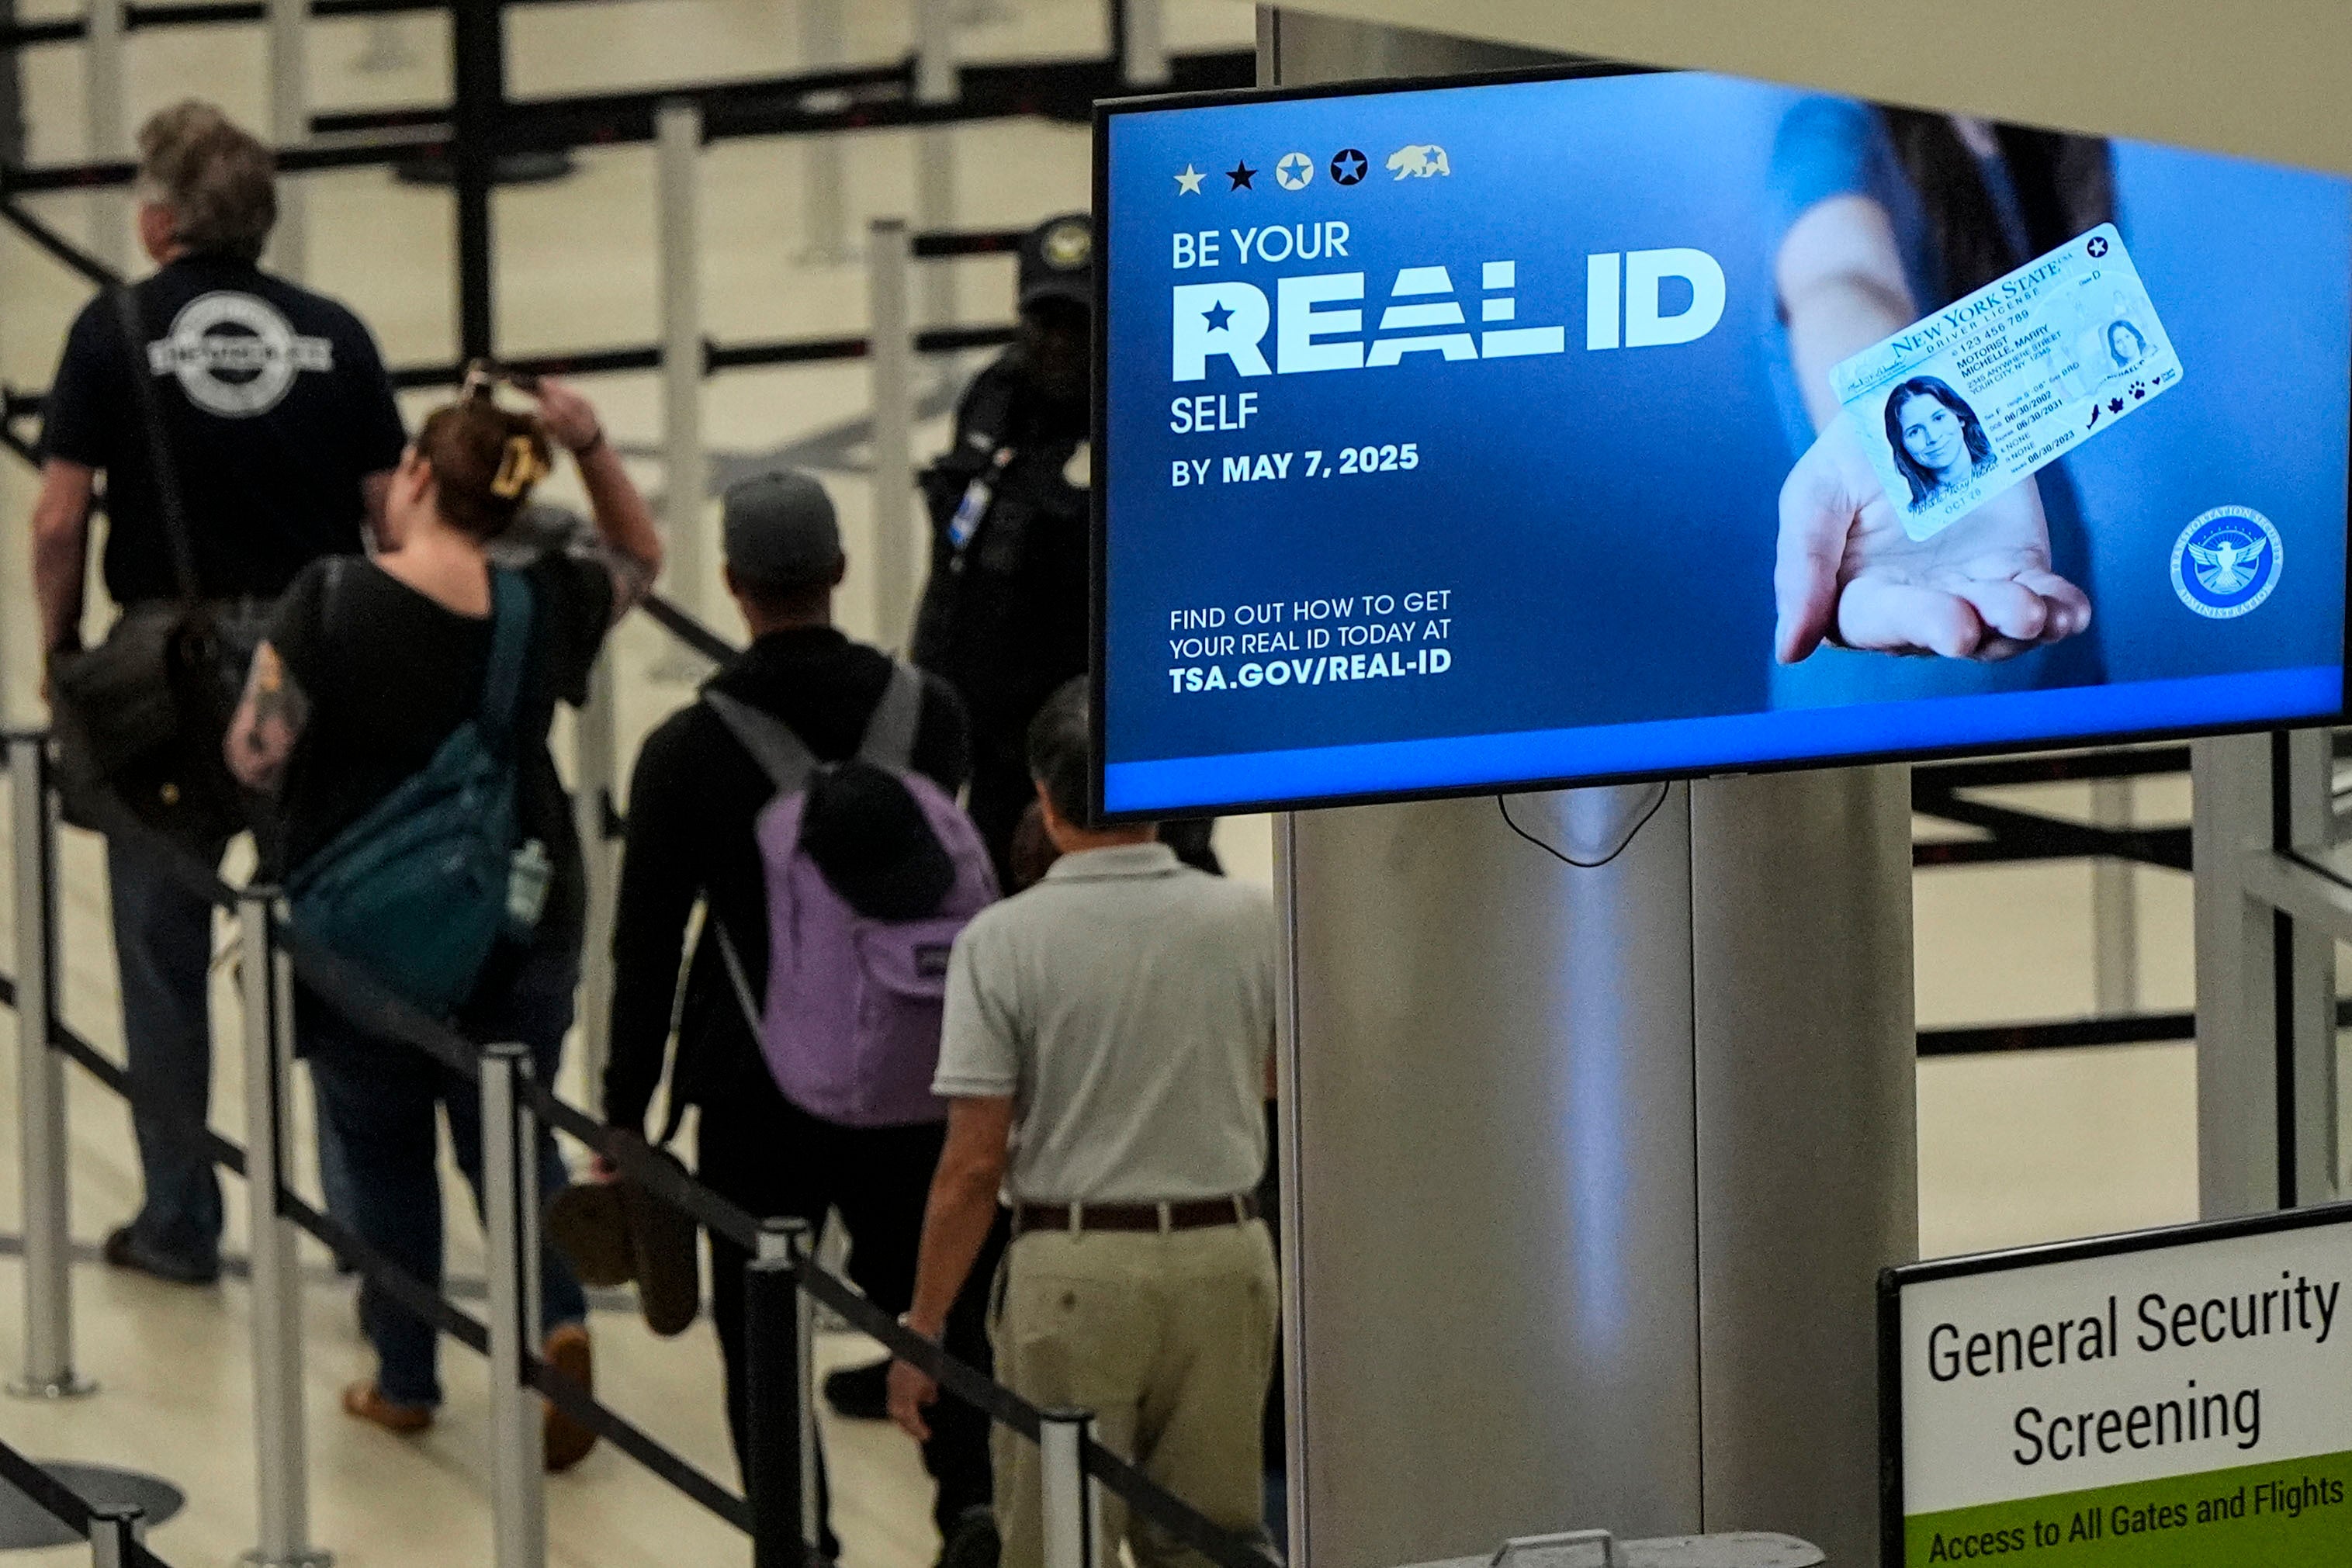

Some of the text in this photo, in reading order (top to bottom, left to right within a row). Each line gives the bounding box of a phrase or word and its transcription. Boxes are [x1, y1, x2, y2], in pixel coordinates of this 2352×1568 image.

[1172, 220, 1350, 269] BE YOUR
[2091, 269, 2101, 280] D
[1172, 247, 1727, 382] REAL ID
[1890, 322, 1940, 358] NEW
[1942, 292, 2001, 328] YORK
[2001, 261, 2061, 299] STATE
[1926, 286, 2040, 353] DRIVER LICENSE
[1959, 308, 2030, 352] 123 456 789
[1955, 334, 2009, 369] MOTORIST
[2014, 324, 2049, 348] MARRY
[1966, 330, 2062, 389] 2345 ANYWHERE STREET
[1970, 378, 1993, 395] YOUR
[2014, 359, 2026, 370] NY
[2029, 345, 2051, 362] 12345
[1170, 392, 1259, 434] SELF
[2004, 389, 2052, 424] 06/30/2002
[2015, 398, 2063, 431] 06/30/2031
[2005, 431, 2031, 450] NONE
[2011, 441, 2035, 459] NONE
[2027, 429, 2075, 463] 06/30/2023
[1172, 442, 1419, 487] BY MAY 7, 2025
[1169, 590, 1452, 630] FIND OUT HOW TO GET
[2177, 583, 2274, 618] ADMINISTRATION
[1169, 618, 1452, 659] YOUR REAL ID TODAY AT
[1169, 648, 1452, 694] TSA.GOV/REAL-ID
[1928, 1270, 2340, 1383] General Security
[2014, 1379, 2262, 1466] Screening
[1928, 1475, 2343, 1563] Access to All Gates and Flights
